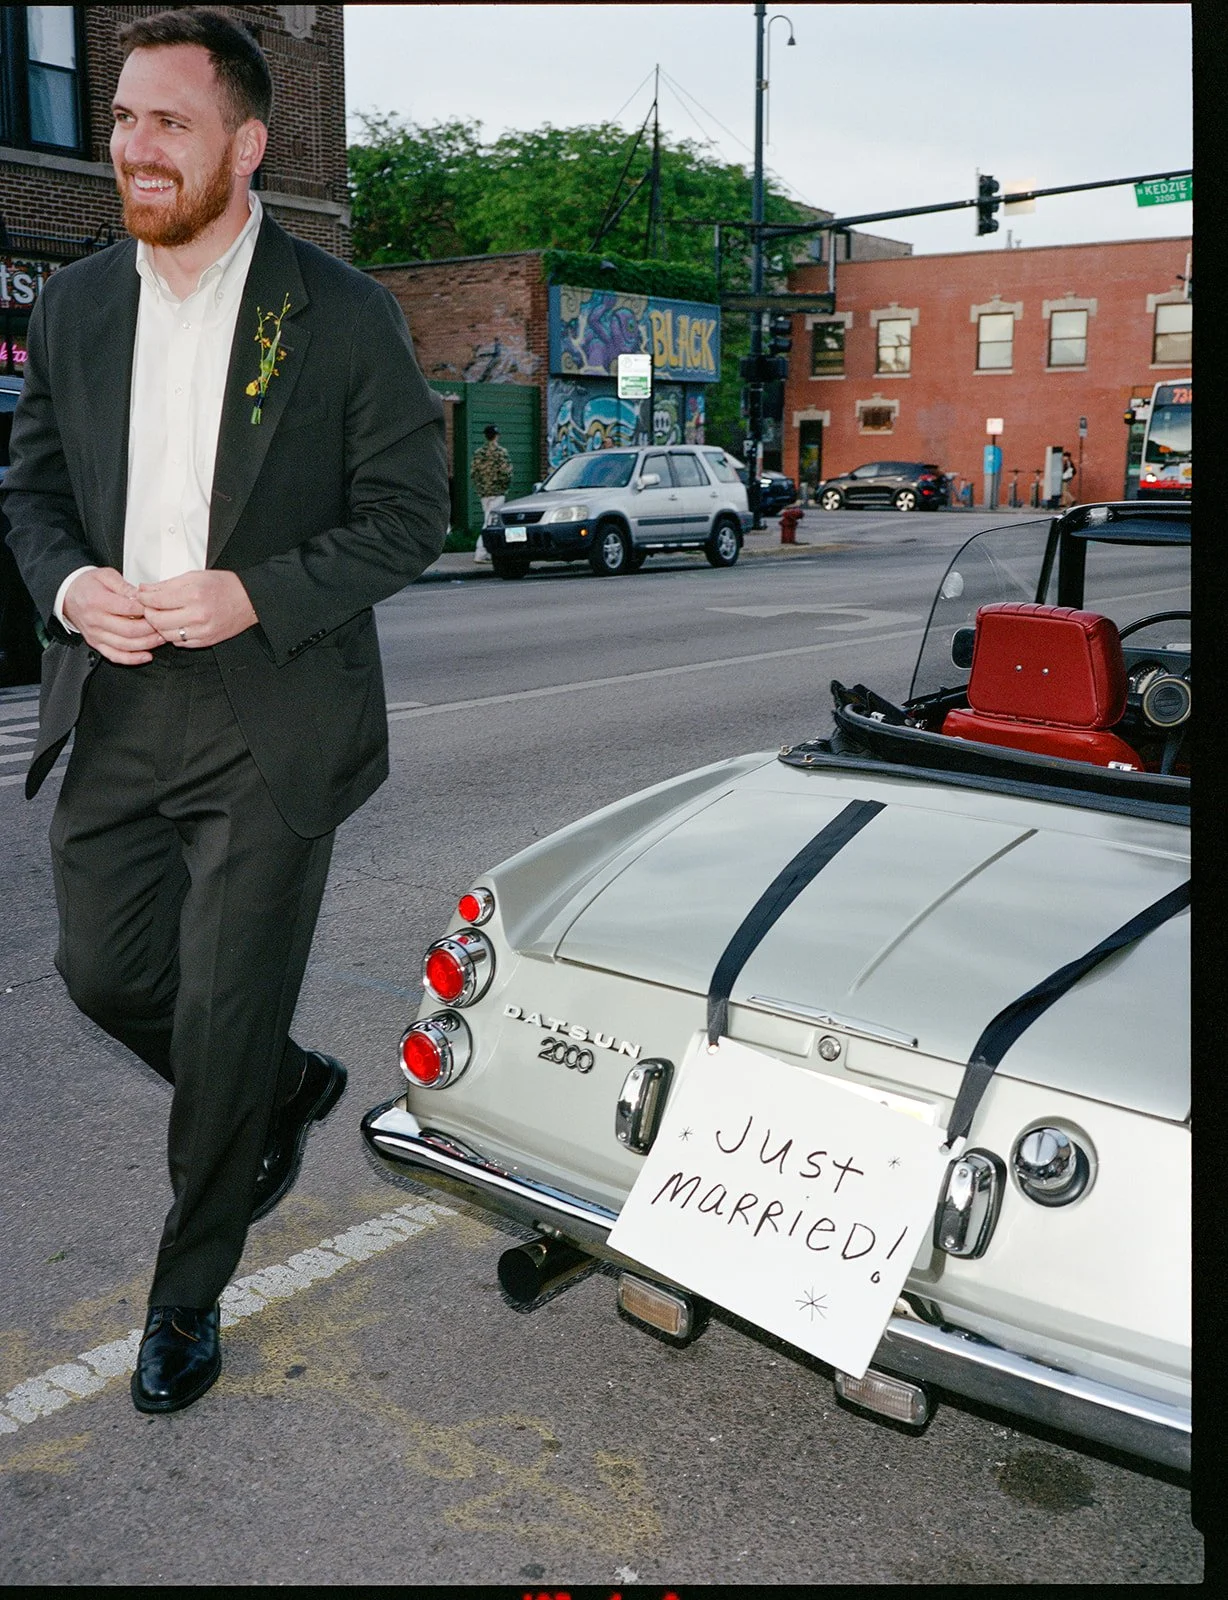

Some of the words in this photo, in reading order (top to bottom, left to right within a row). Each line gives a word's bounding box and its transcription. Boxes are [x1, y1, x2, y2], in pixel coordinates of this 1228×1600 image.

[1144, 181, 1187, 195] KEDZIE
[1155, 193, 1176, 203] 3200
[648, 309, 717, 372] BLACK
[503, 1003, 642, 1059] DATSUN
[537, 1036, 595, 1074] 2000
